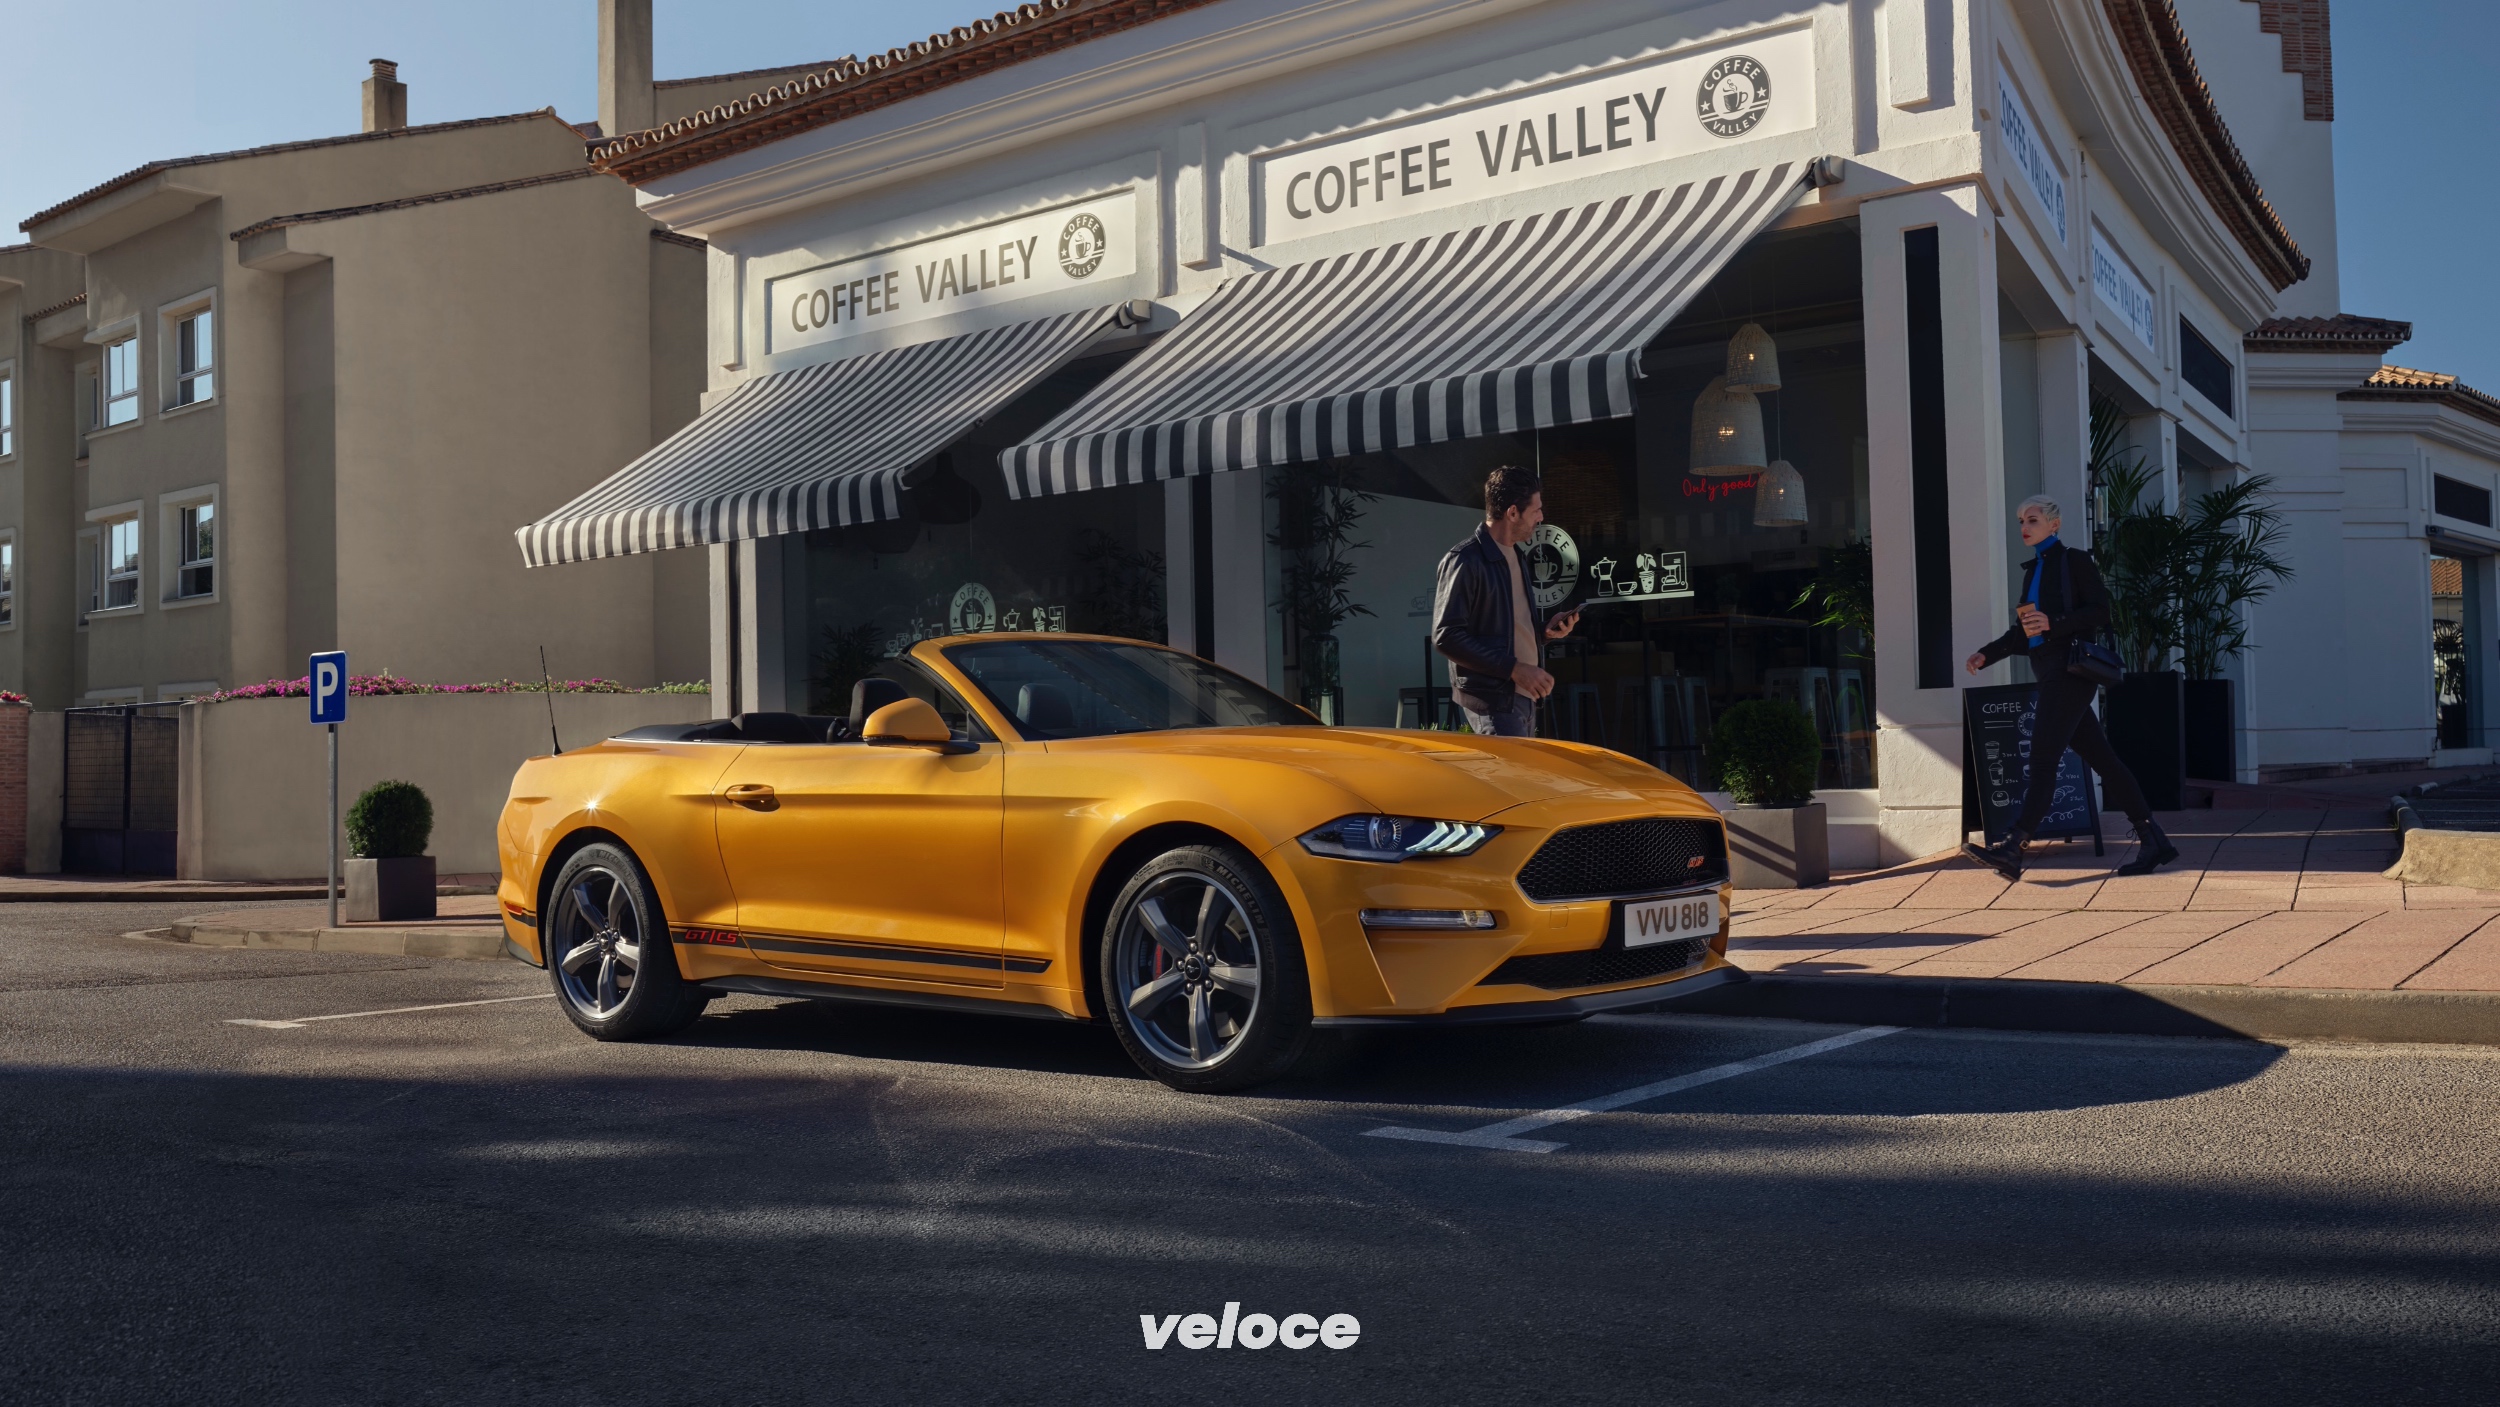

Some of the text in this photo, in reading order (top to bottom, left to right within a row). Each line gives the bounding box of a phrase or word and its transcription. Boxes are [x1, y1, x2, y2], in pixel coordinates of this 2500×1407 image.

[1704, 60, 1761, 90] COFFEE
[1713, 112, 1757, 134] VALLEY
[1286, 86, 1668, 220] COFFEE VALLEY
[2028, 136, 2054, 217] VALLEY
[1063, 216, 1099, 241] COFFEE
[1068, 259, 1097, 276] VALLEY
[791, 235, 1039, 333] COFFEE VALLEY
[1682, 477, 1720, 501] Only
[1721, 473, 1757, 497] good
[954, 586, 990, 608] COFFEE
[1538, 586, 1565, 603] LLEY
[317, 661, 339, 716] P
[1982, 702, 2022, 714] COFFEE
[1216, 865, 1265, 924] MICHELIN
[1636, 901, 1709, 937] VVU 818
